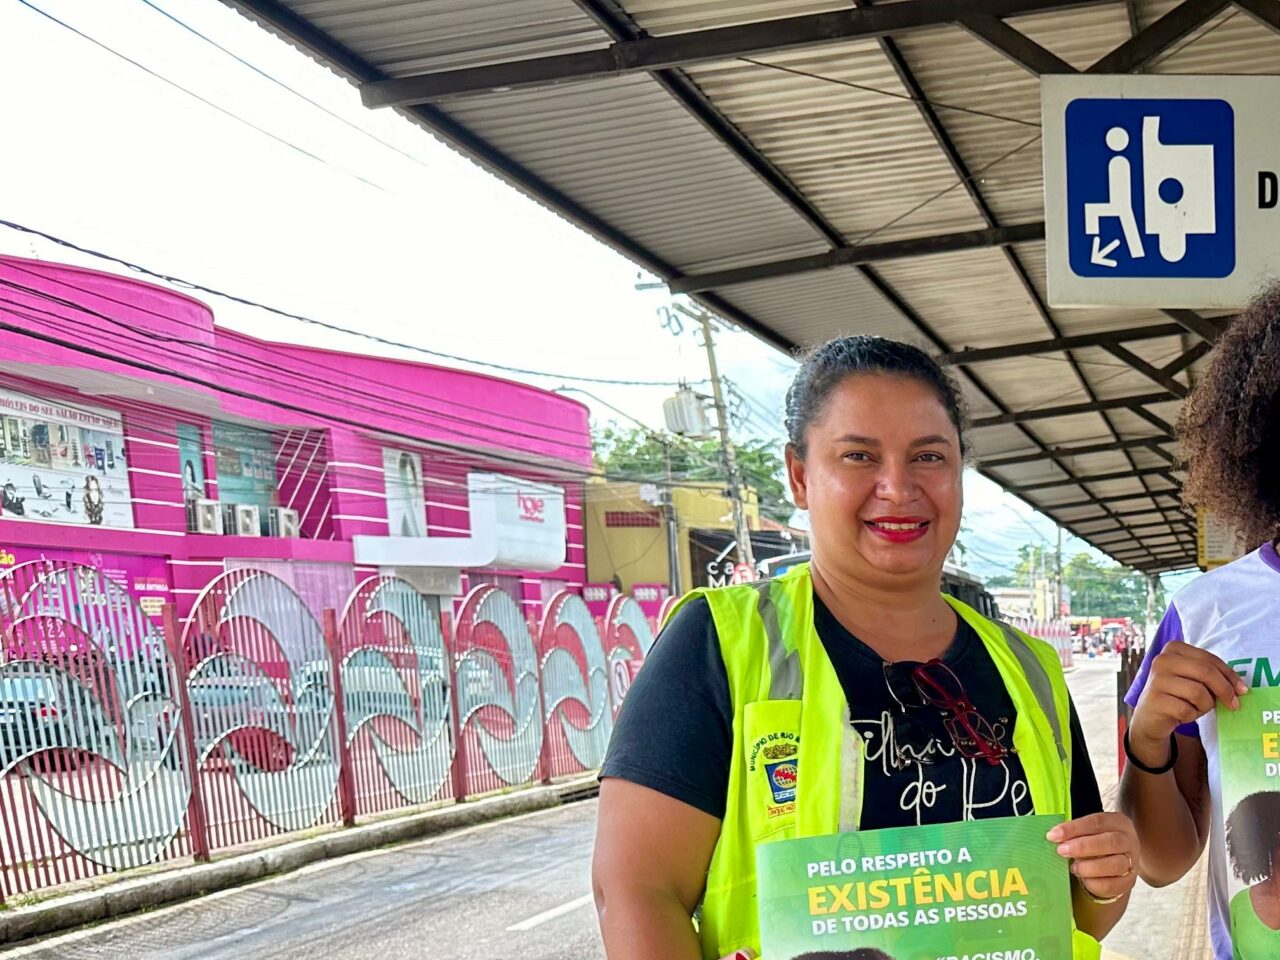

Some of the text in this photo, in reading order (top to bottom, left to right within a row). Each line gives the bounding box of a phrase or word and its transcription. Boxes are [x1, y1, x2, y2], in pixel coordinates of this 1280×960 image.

[807, 847, 972, 878] PELO RESPEITO A
[807, 867, 1029, 915] EXISTÊNCIA
[812, 901, 1028, 936] DE TODAS AS PESSOAS
